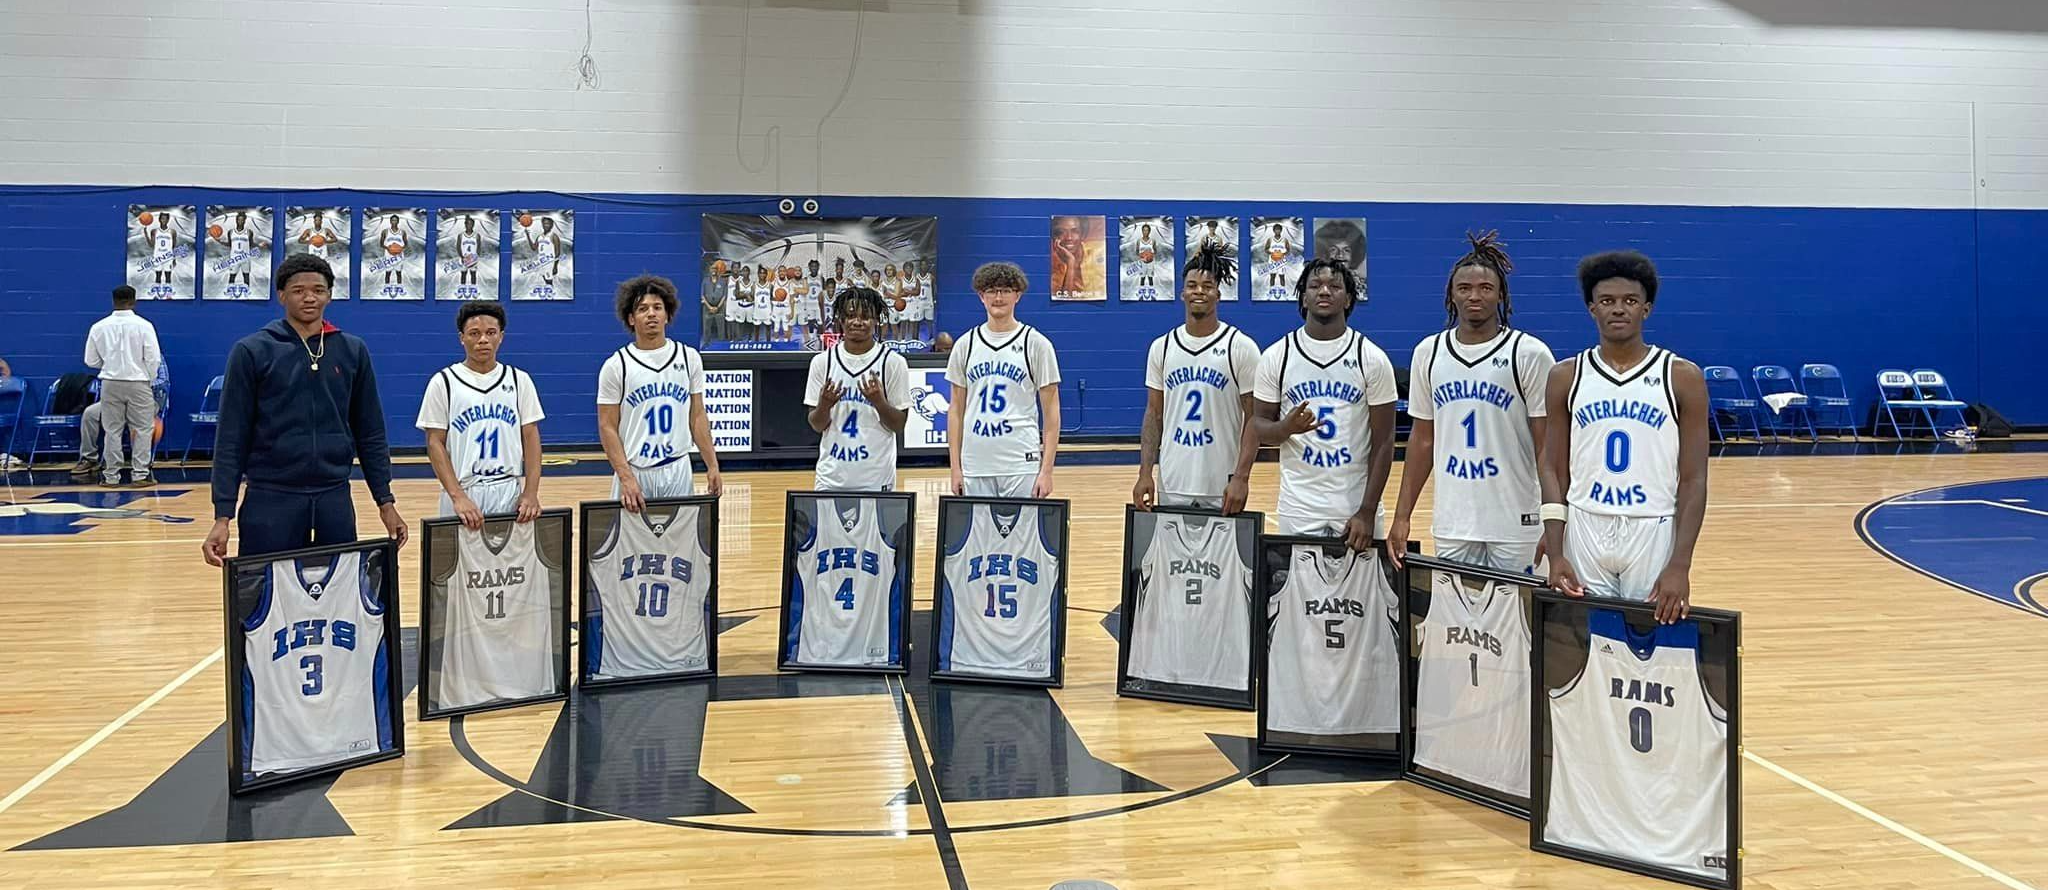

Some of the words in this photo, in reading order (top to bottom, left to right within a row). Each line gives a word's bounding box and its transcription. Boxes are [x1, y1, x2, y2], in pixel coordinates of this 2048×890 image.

[705, 374, 751, 383] NATION
[966, 360, 1026, 386] INTERLACHEN
[1165, 365, 1230, 392] INTERLACHEN
[626, 382, 690, 408] INTERLACHEN
[705, 389, 751, 398] NATION
[978, 384, 1007, 414] 15
[1185, 390, 1202, 421] 2
[1285, 380, 1364, 405] INTERLACHEN
[1434, 380, 1515, 412] INTERLACHEN
[452, 403, 517, 433] INTERLACHEN
[644, 404, 673, 435] 10
[705, 404, 750, 413] NATION
[1316, 406, 1336, 440] 5
[1575, 399, 1668, 431] INTERLACHEN
[841, 409, 858, 438] 4
[925, 430, 949, 444] IH
[972, 419, 1013, 437] RAMS
[1174, 427, 1214, 447] RAMS
[1461, 409, 1476, 449] 1
[475, 427, 498, 459] 11
[713, 437, 750, 446] ATION
[830, 443, 869, 462] RAMS
[1302, 445, 1352, 467] RAMS
[1604, 429, 1631, 474] 0
[1446, 454, 1499, 480] RAMS
[1590, 481, 1647, 506] RAMS
[620, 554, 692, 584] IHS
[817, 548, 879, 576] IHS
[968, 553, 1038, 585] IHS
[1169, 558, 1221, 580] RAMS
[467, 566, 525, 588] RAMS
[1185, 578, 1202, 605] 2
[485, 590, 506, 619] 11
[635, 582, 669, 617] 10
[835, 577, 855, 610] 4
[984, 583, 1017, 618] 15
[1305, 598, 1364, 618] RAMS
[272, 619, 356, 661] IHS
[1325, 619, 1345, 649] 5
[1446, 626, 1502, 658] RAMS
[300, 654, 324, 696] 3
[1468, 652, 1479, 687] 1
[1610, 677, 1675, 708] RAMS
[1628, 706, 1653, 753] 0
